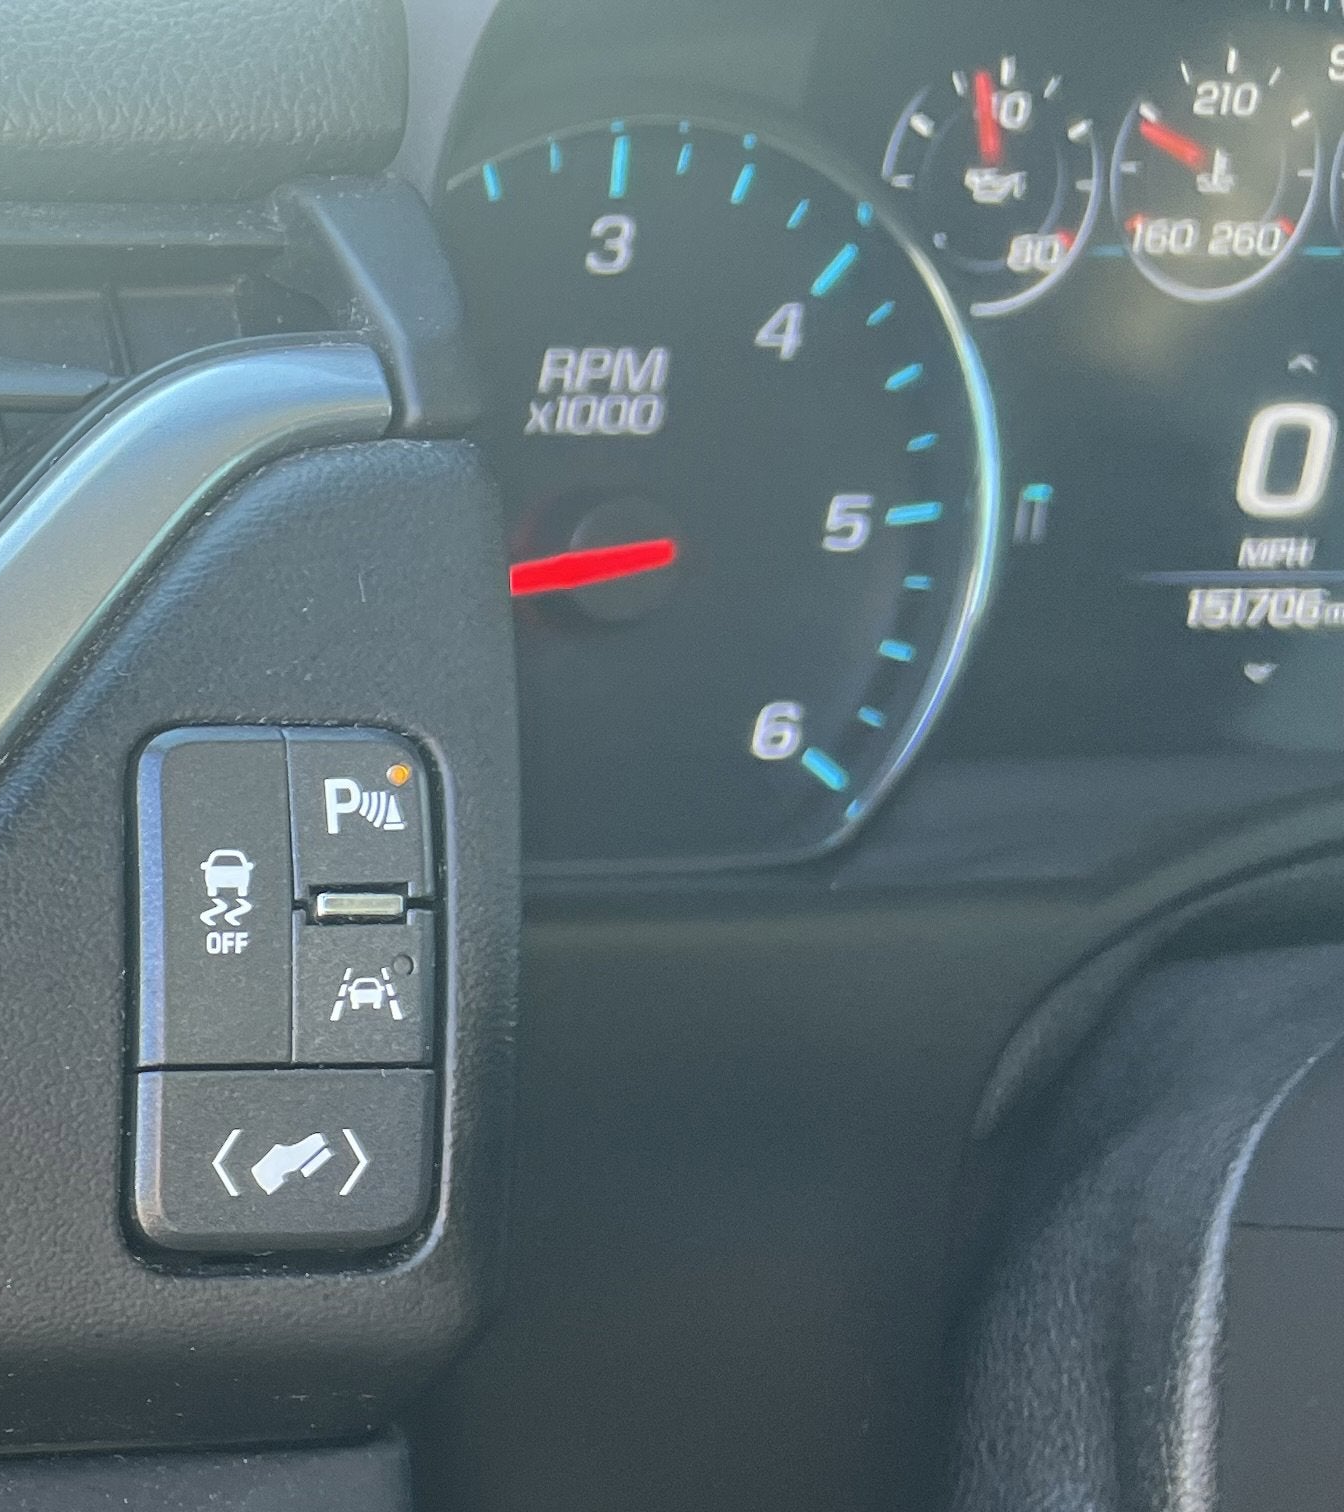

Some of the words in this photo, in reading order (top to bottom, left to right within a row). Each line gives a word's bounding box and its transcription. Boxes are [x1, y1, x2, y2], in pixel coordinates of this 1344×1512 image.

[1193, 81, 1258, 117] 210
[585, 214, 637, 275] 3
[1132, 218, 1199, 256] 160
[1208, 220, 1281, 256] 260
[754, 302, 805, 361] 4
[538, 347, 670, 393] RPM
[523, 395, 666, 435] x1000
[1236, 402, 1338, 518] 0
[822, 494, 874, 552] 5
[1238, 537, 1317, 568] MPH
[751, 702, 804, 761] 6
[323, 778, 360, 834] P
[206, 931, 249, 955] OFF
